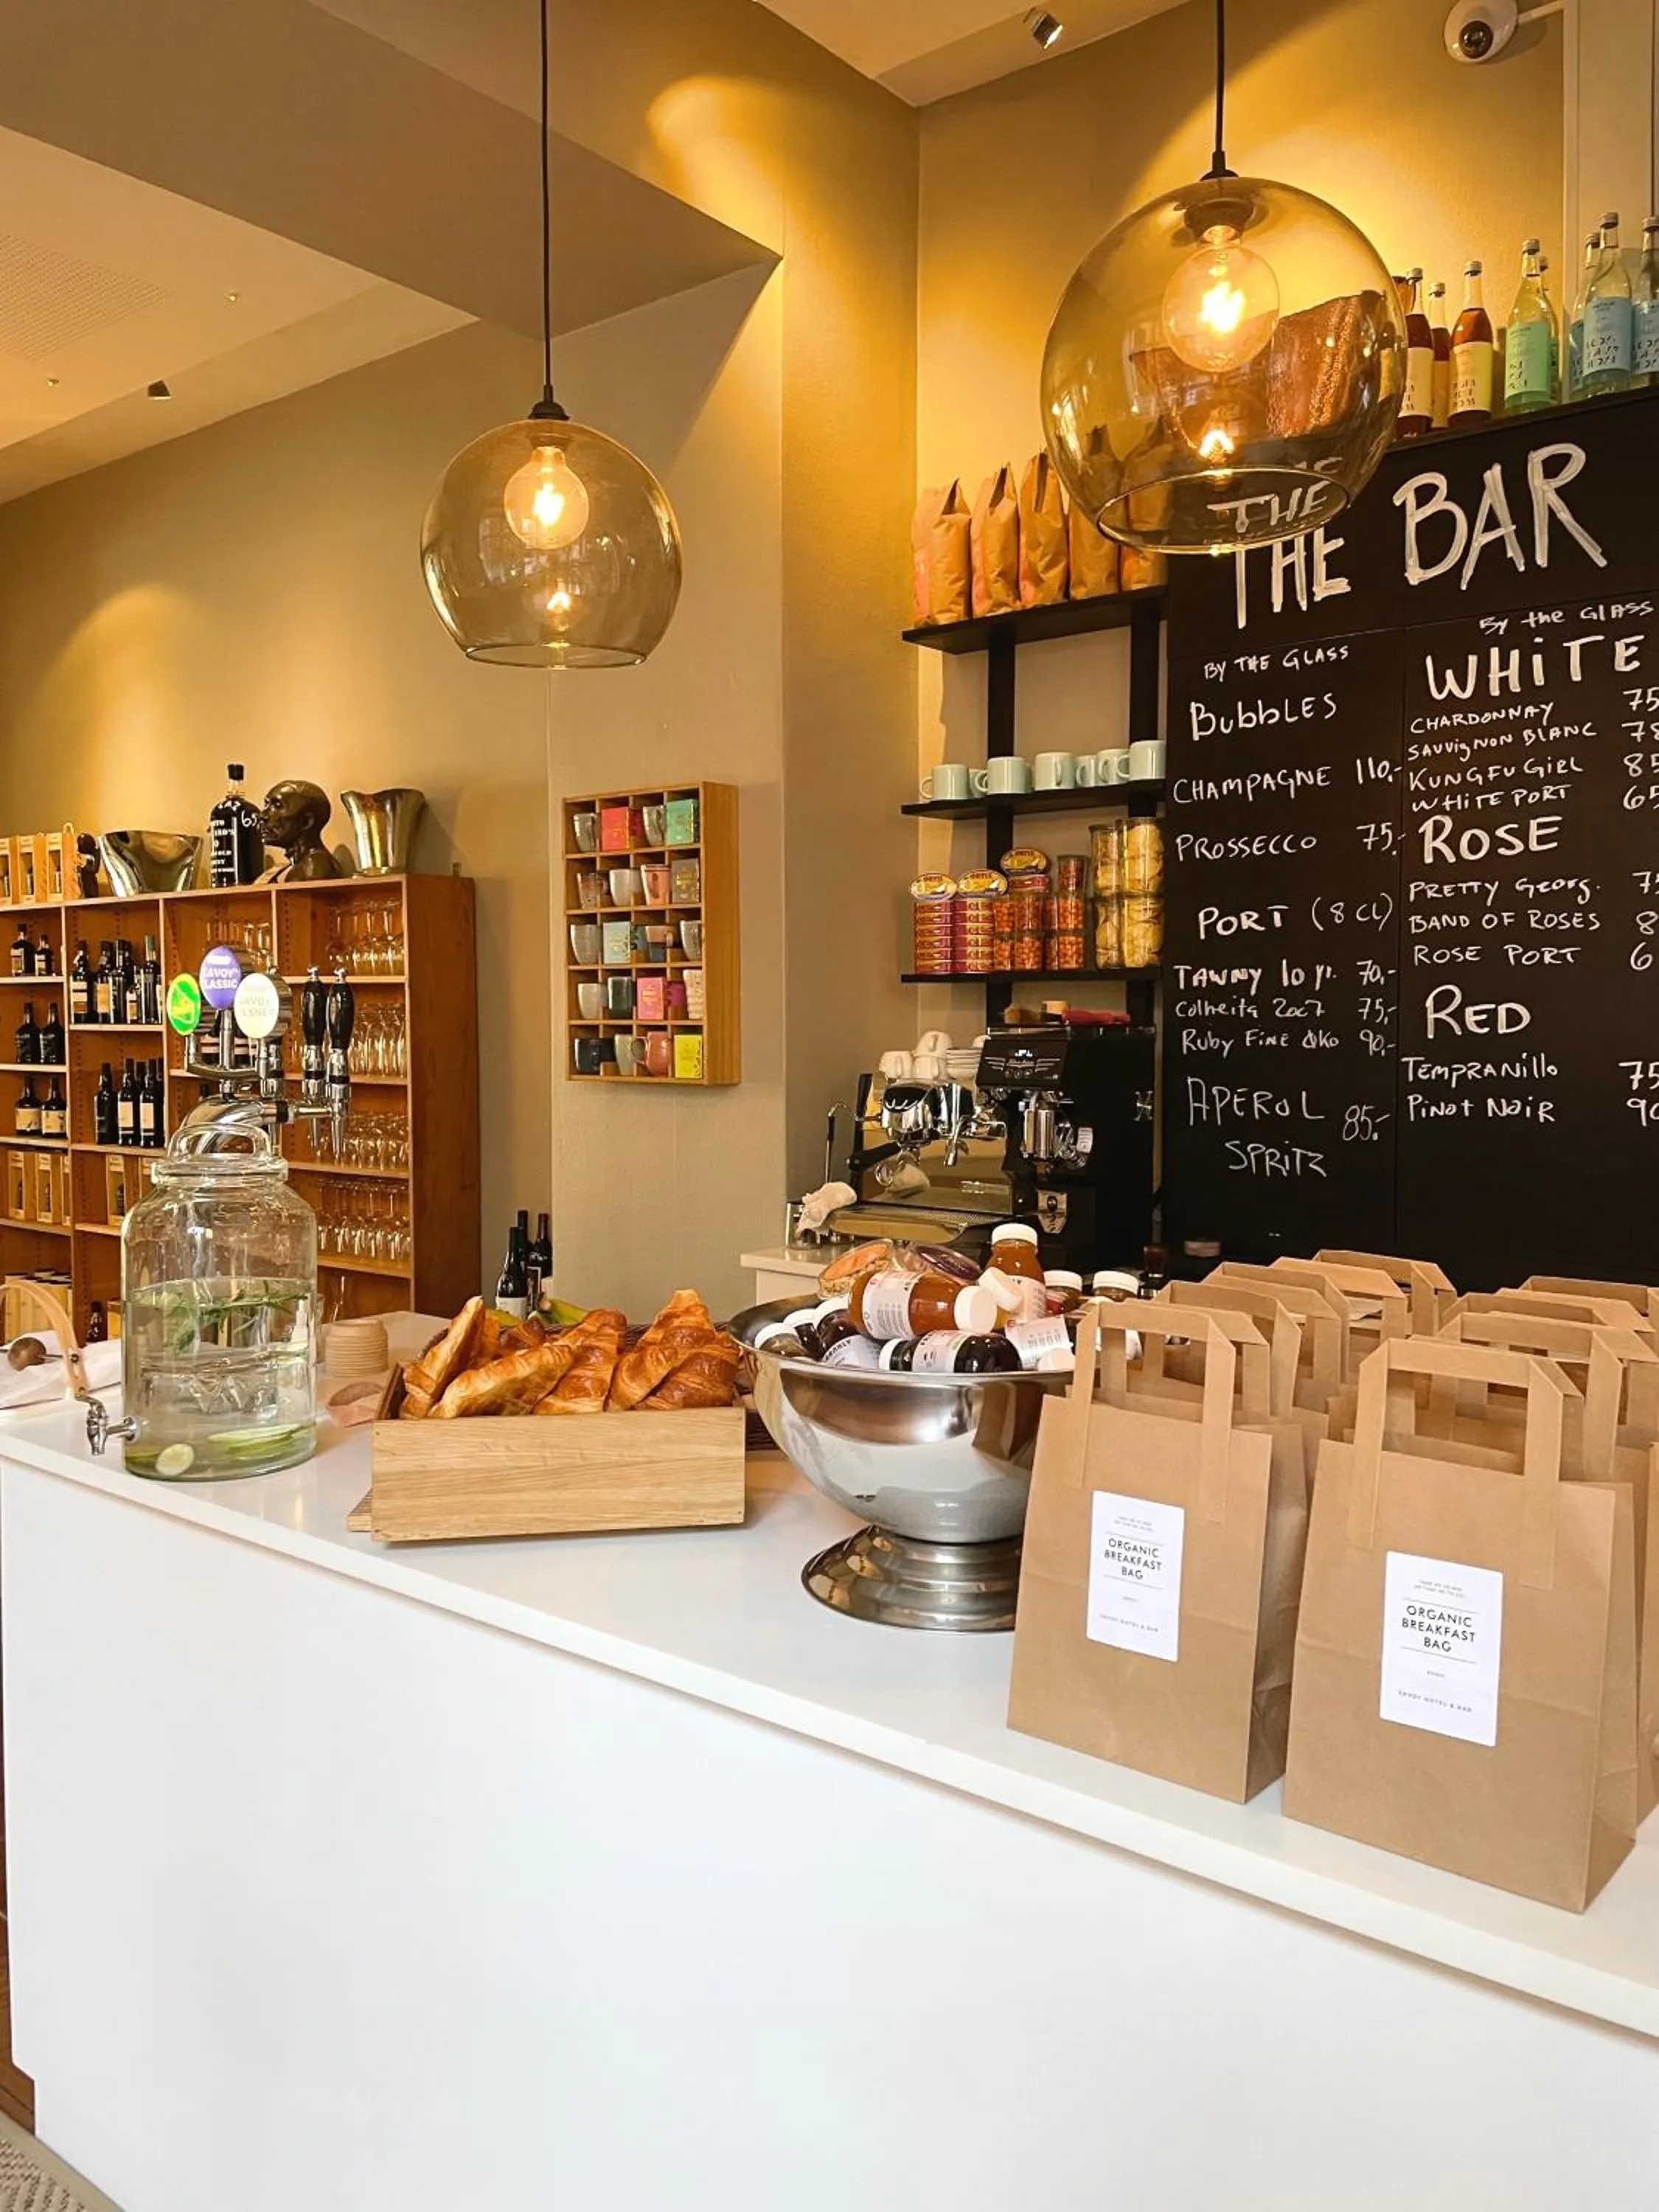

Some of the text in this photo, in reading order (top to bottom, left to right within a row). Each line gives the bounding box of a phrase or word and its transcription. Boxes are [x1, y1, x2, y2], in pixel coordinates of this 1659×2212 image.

[1393, 442, 1607, 591] BAR
[1521, 610, 1566, 627] the
[1204, 645, 1349, 682] BY THE GLASS
[1410, 701, 1554, 734] CHARDONNAY
[1173, 766, 1332, 803] CHAMPAGNE
[1511, 784, 1572, 807] PORT
[1175, 834, 1317, 862] PROSSECCO
[1418, 815, 1563, 865] ROSE
[1409, 880, 1499, 907] PRETTY
[1198, 904, 1289, 940] PORT
[1408, 914, 1470, 933] BAND
[1482, 912, 1515, 930] OF
[1527, 909, 1601, 931] ROSES
[1413, 945, 1482, 966] ROSE
[1503, 944, 1581, 966] PORT
[1173, 964, 1262, 996] TAWNY
[1425, 984, 1531, 1039] RED
[1182, 1029, 1234, 1058] Ruby
[1186, 1076, 1325, 1127] APEROL
[1104, 1549, 1162, 1571] BREAKFAST
[1108, 1537, 1159, 1559] ORGANIC
[1121, 1565, 1144, 1580] BAG
[1406, 1604, 1472, 1628] ORGANIC
[1402, 1618, 1475, 1644] BREAKFAST
[1424, 1636, 1452, 1653] BAG
